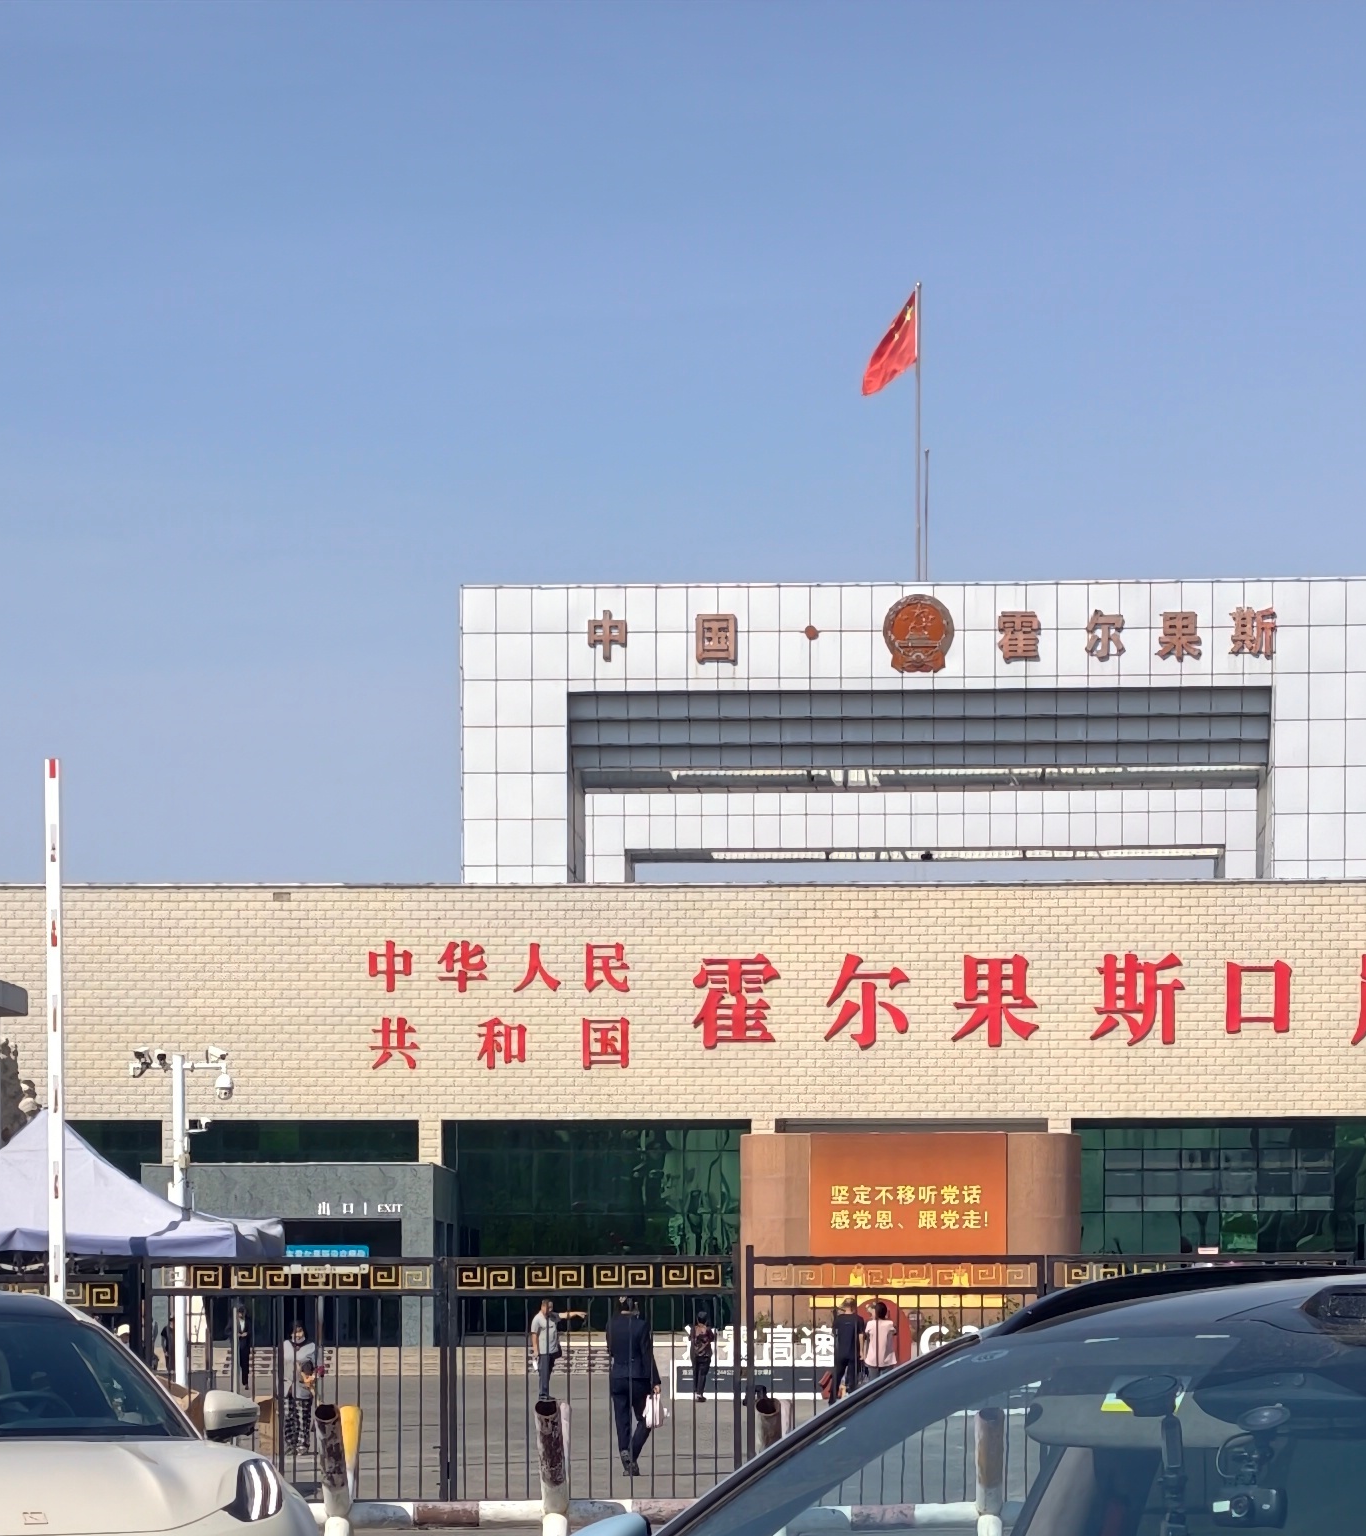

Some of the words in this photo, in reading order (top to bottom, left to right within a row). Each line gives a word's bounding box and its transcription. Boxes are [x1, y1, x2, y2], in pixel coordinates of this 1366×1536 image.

[996, 606, 1279, 662] 霍尔果斯
[368, 940, 630, 993] 中华人民
[369, 1017, 630, 1070] 共和国
[317, 1201, 354, 1216] 出口
[377, 1203, 403, 1213] EXIT
[830, 1185, 982, 1205] 坚定不移听党话
